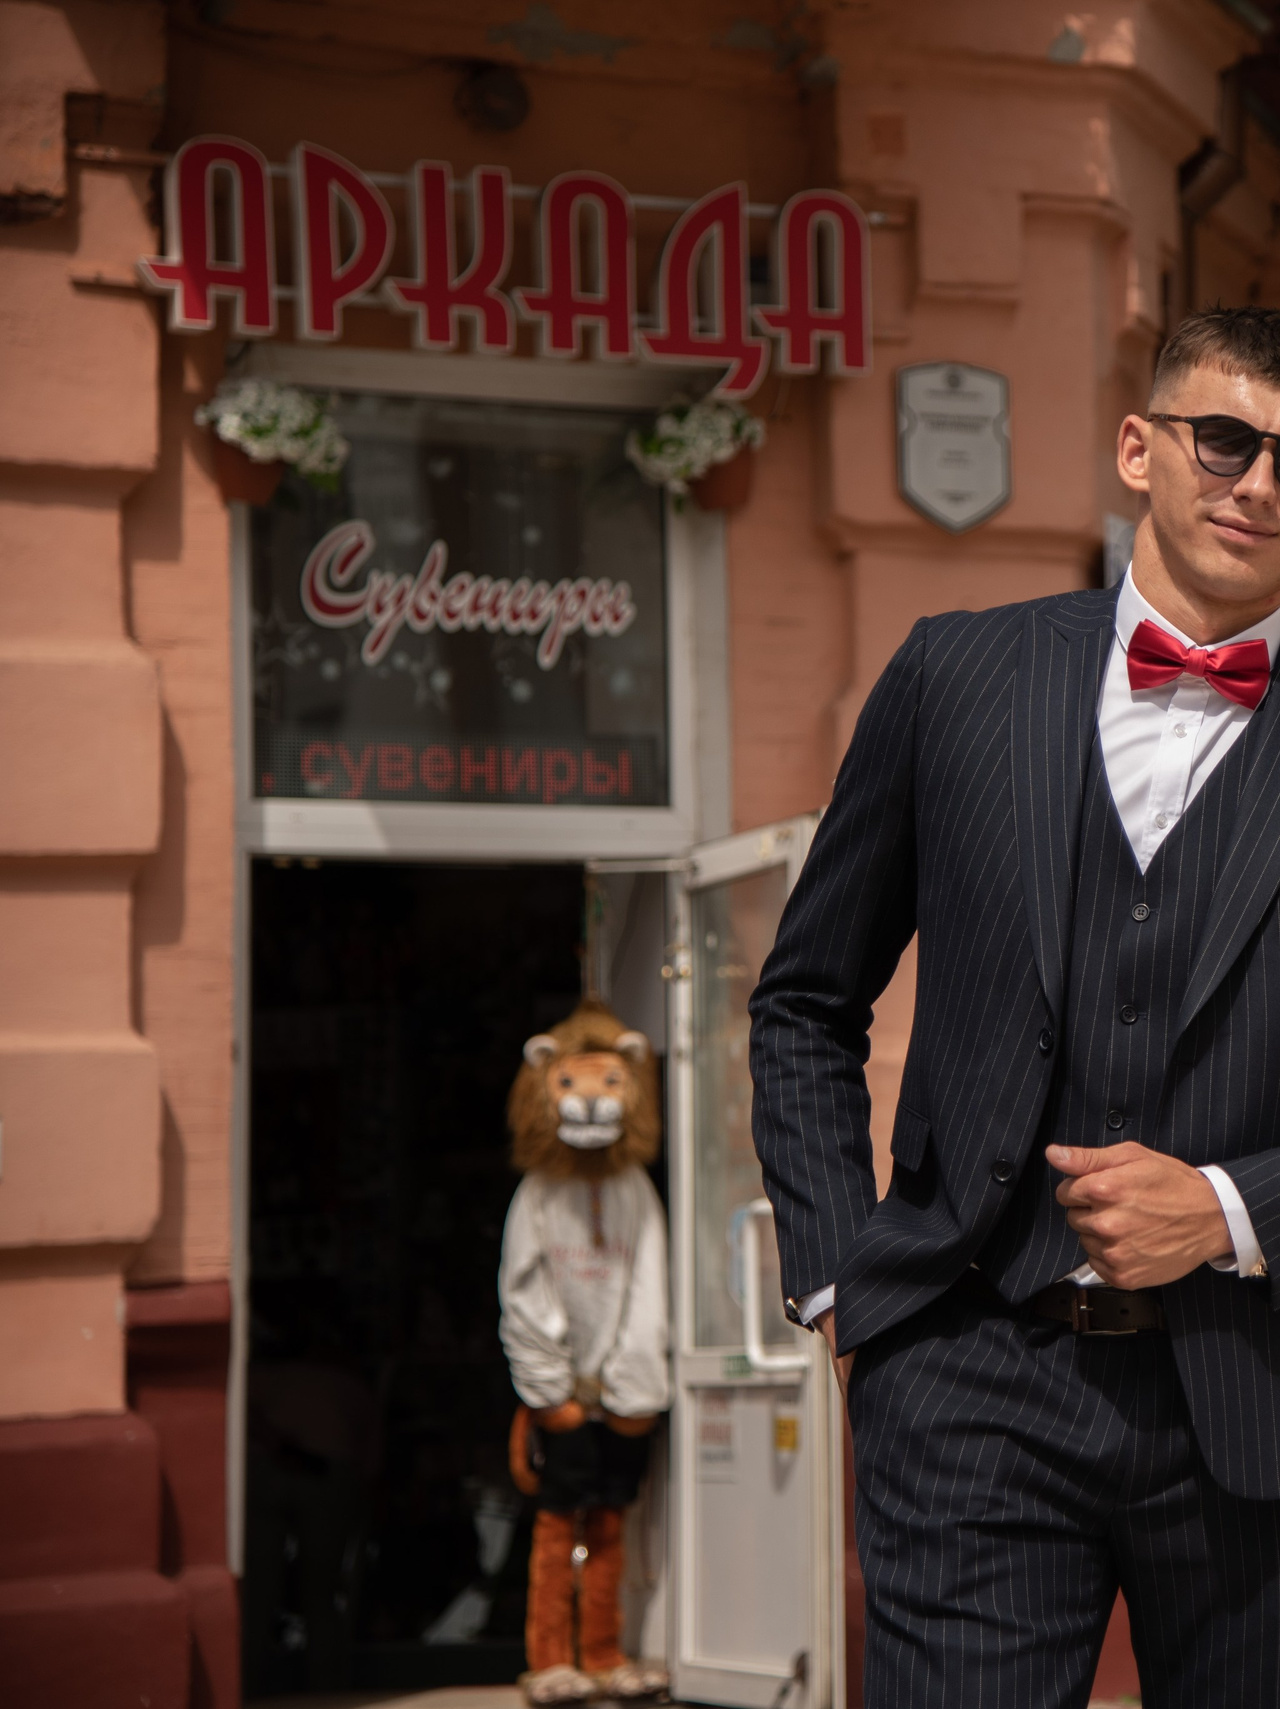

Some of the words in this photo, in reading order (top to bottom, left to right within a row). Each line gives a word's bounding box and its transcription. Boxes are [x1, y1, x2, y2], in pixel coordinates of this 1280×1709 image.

[138, 135, 872, 397] АРКАДА
[302, 519, 636, 669] Сувениры
[300, 740, 633, 804] сувениры
